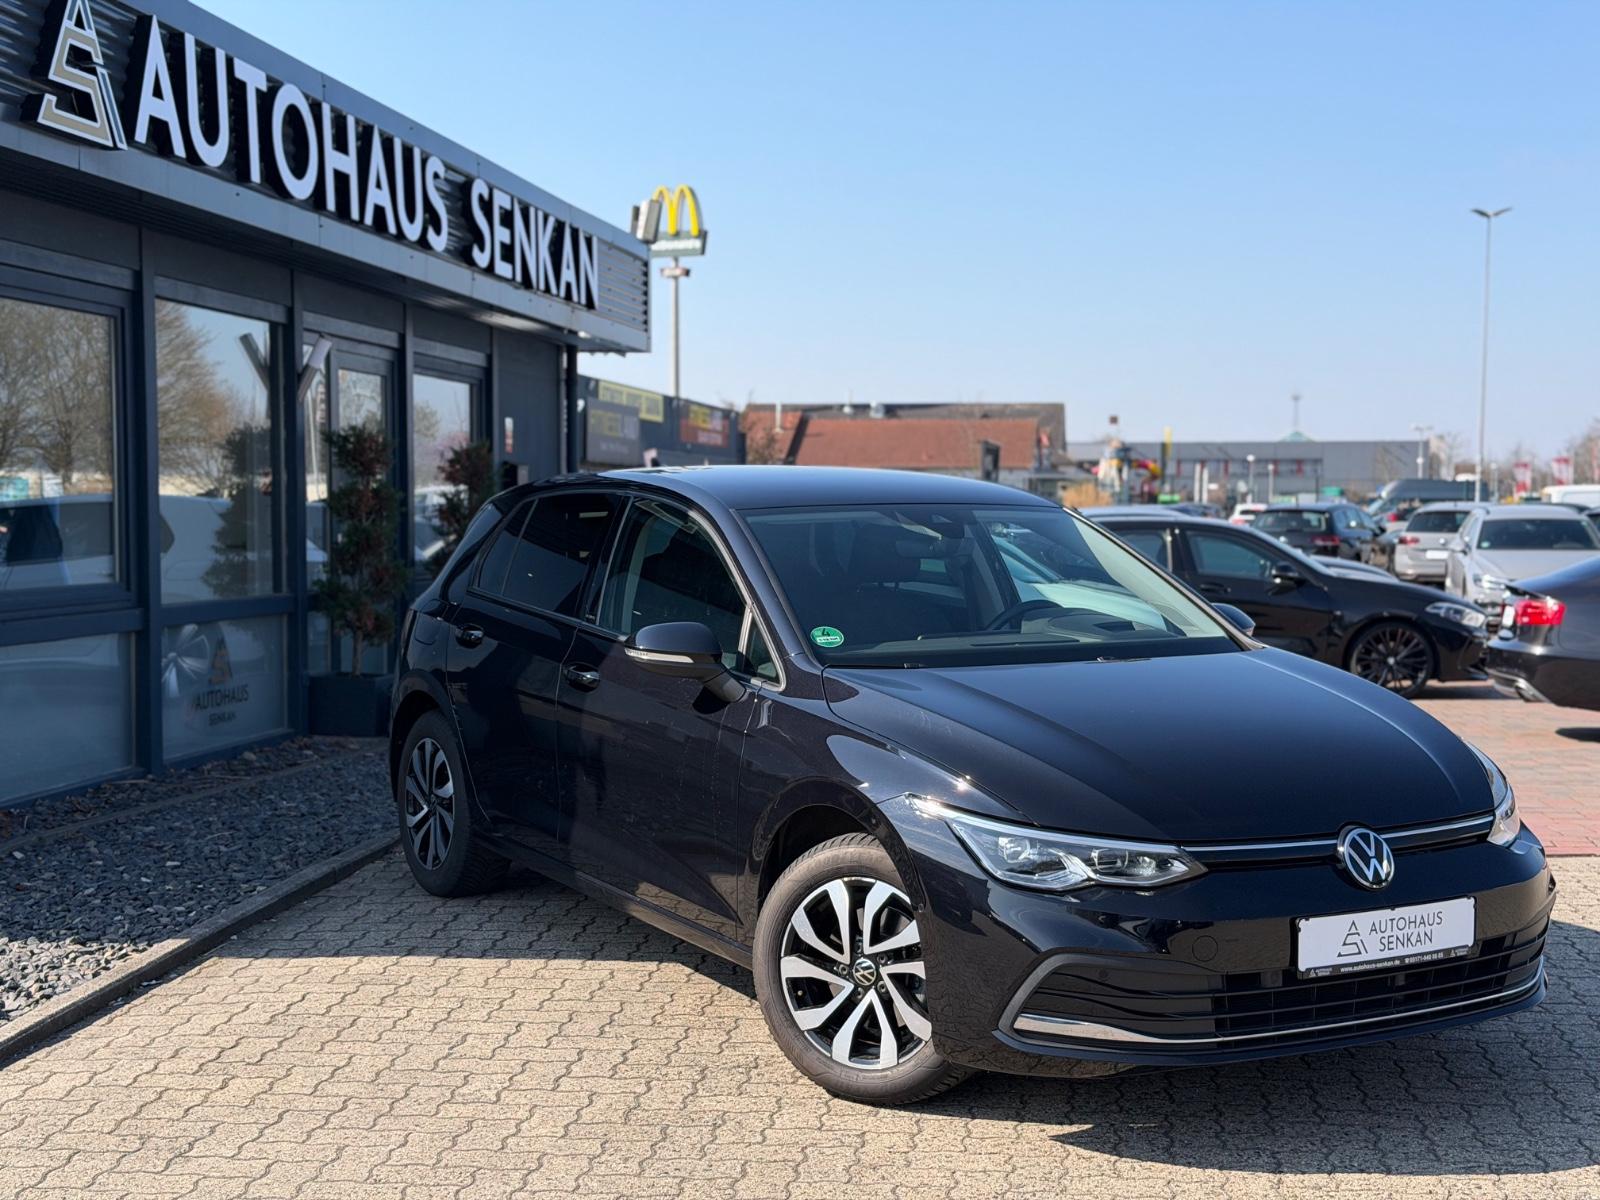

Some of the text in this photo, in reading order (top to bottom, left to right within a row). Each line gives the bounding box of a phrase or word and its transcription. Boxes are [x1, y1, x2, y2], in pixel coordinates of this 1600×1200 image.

[134, 14, 599, 309] AUTOHAUS SENKAN
[193, 684, 248, 711] AUTOHAUS
[1369, 911, 1443, 936] AUTOHAUS
[1379, 929, 1433, 952] SENKAN
